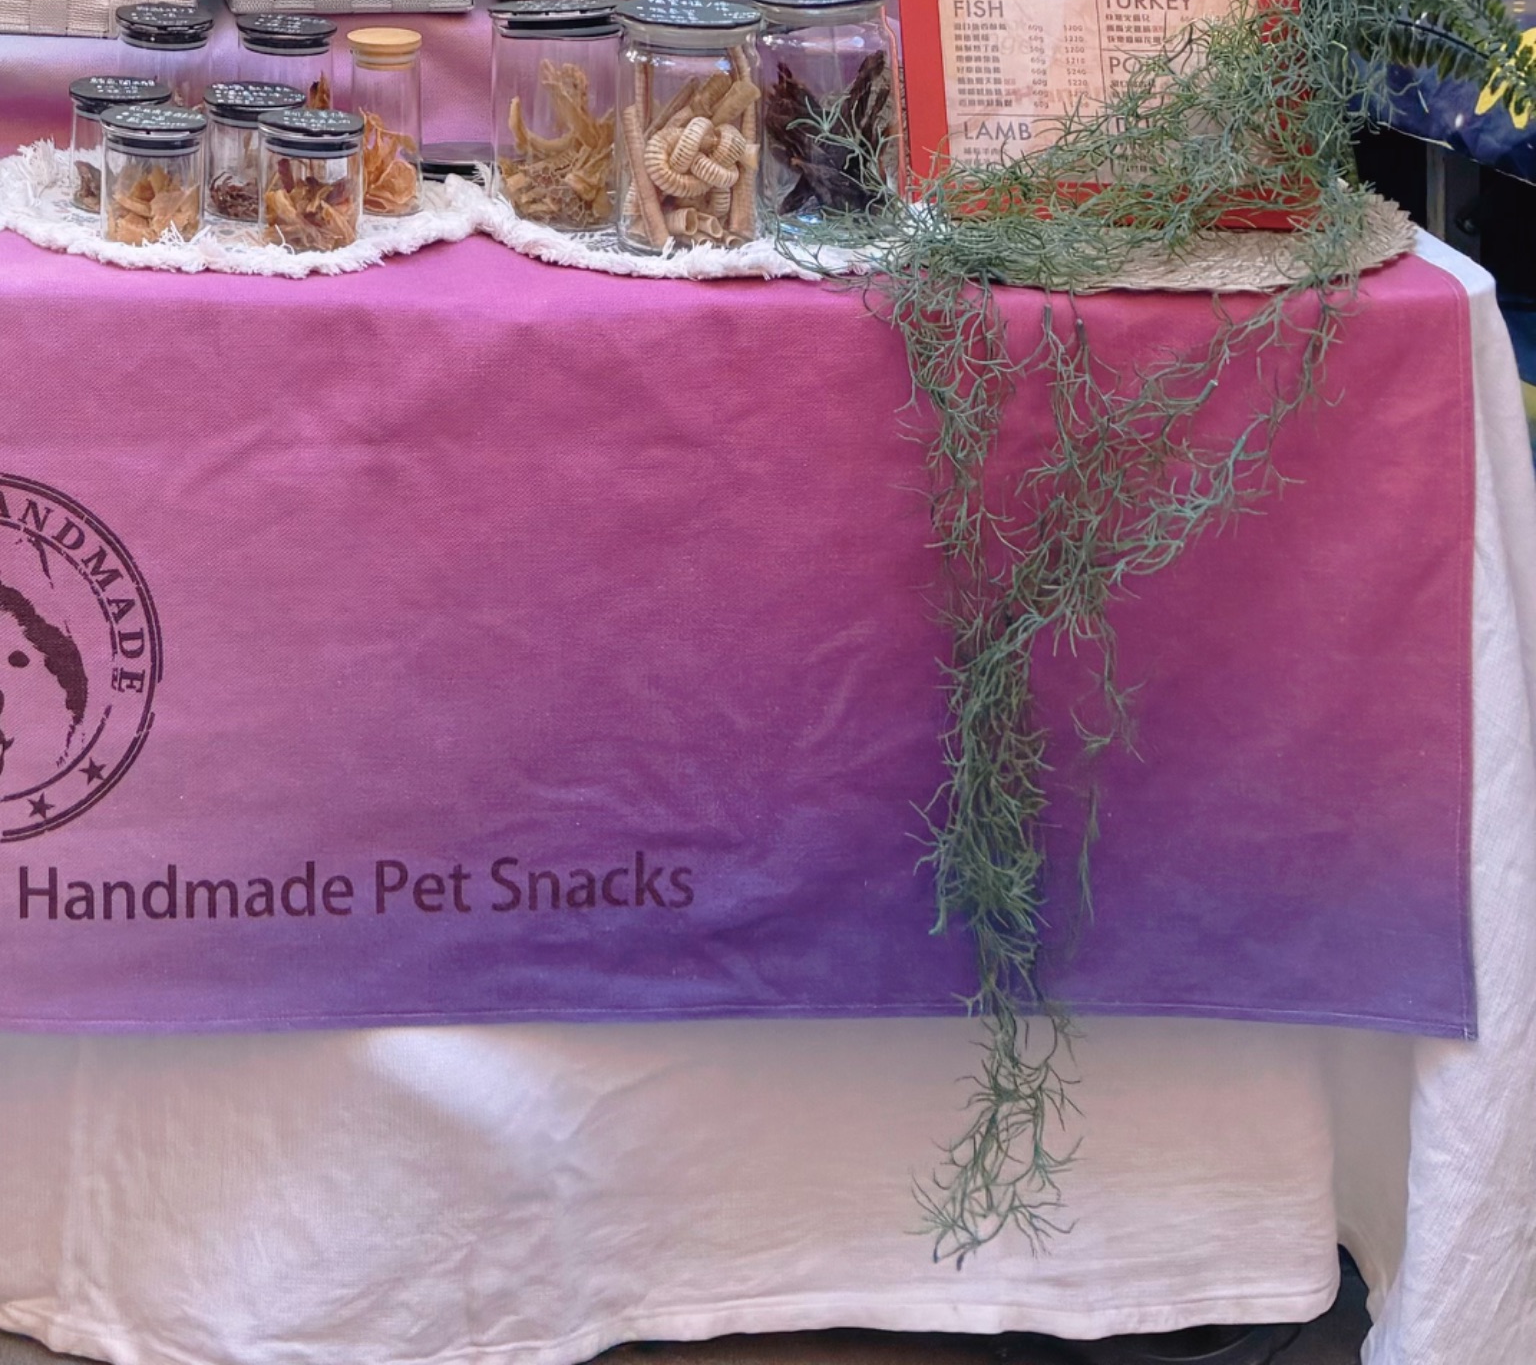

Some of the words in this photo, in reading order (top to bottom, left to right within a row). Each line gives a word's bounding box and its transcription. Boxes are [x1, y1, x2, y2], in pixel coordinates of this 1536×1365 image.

[953, 0, 1005, 19] FISH
[963, 121, 1032, 141] LAMB
[18, 861, 355, 922] Handmade
[375, 858, 472, 915] Pet
[490, 850, 695, 914] Snacks
